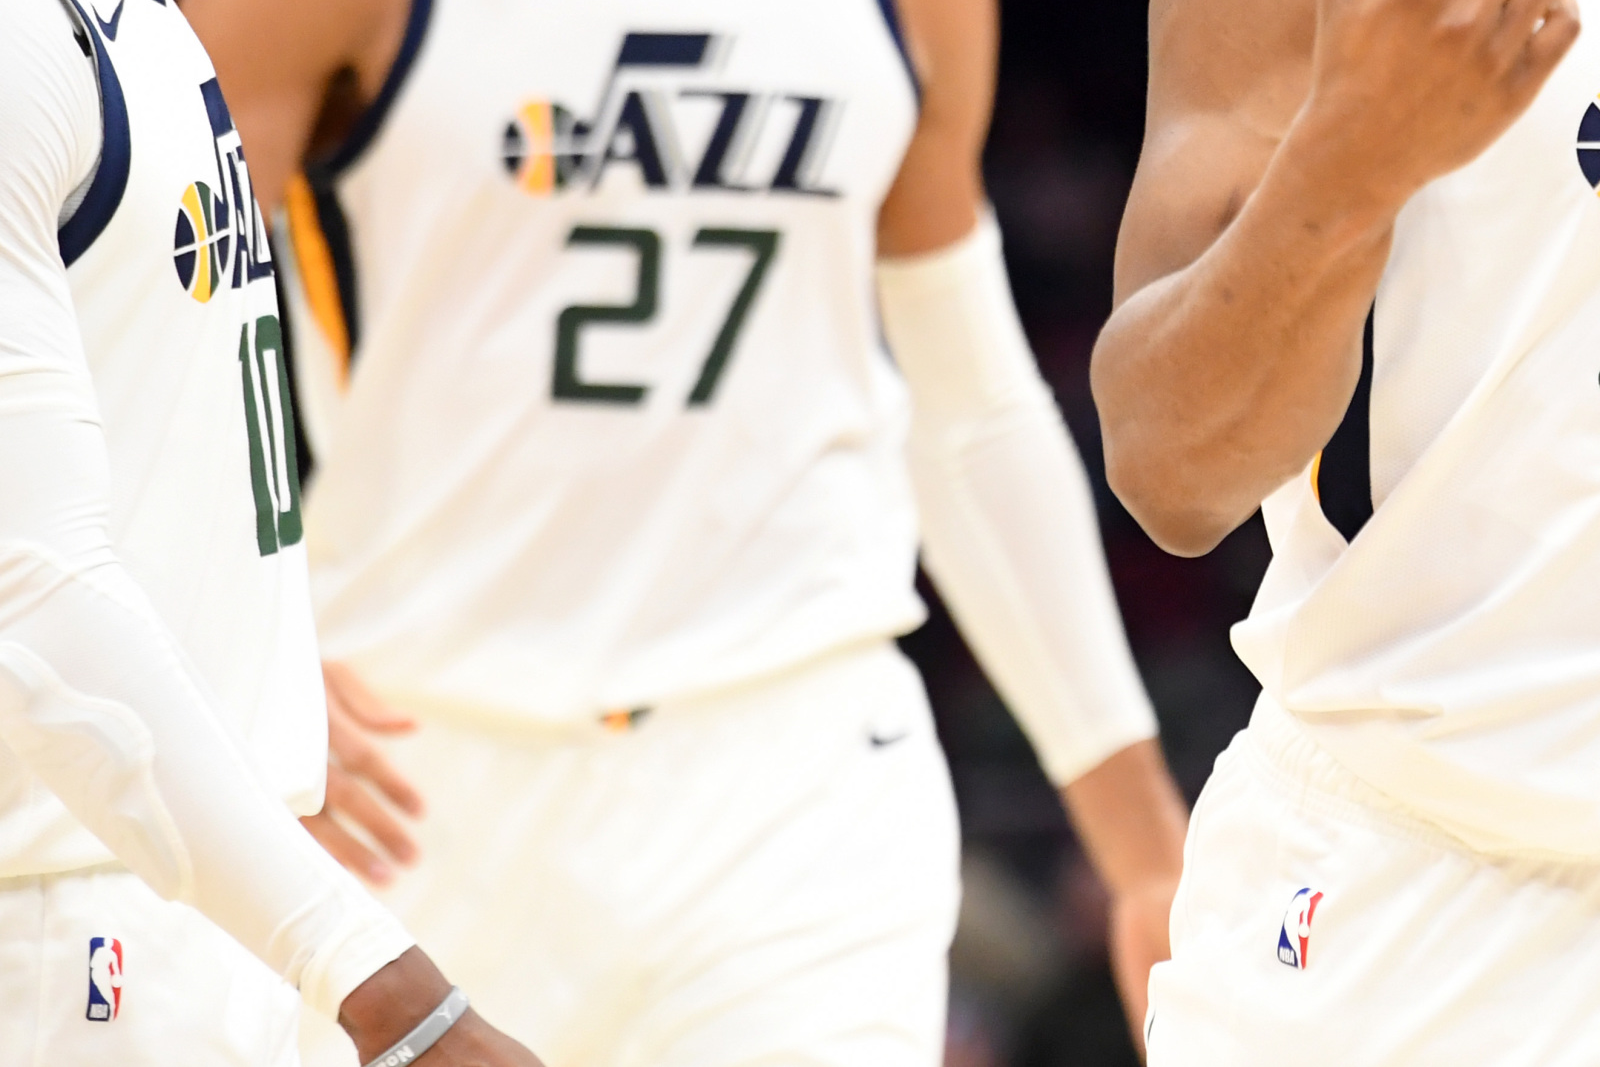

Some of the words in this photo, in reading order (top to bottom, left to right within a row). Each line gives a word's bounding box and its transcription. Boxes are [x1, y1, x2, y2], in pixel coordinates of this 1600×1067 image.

[500, 32, 847, 198] JAZZ
[551, 225, 784, 409] 27
[238, 314, 302, 557] 10
